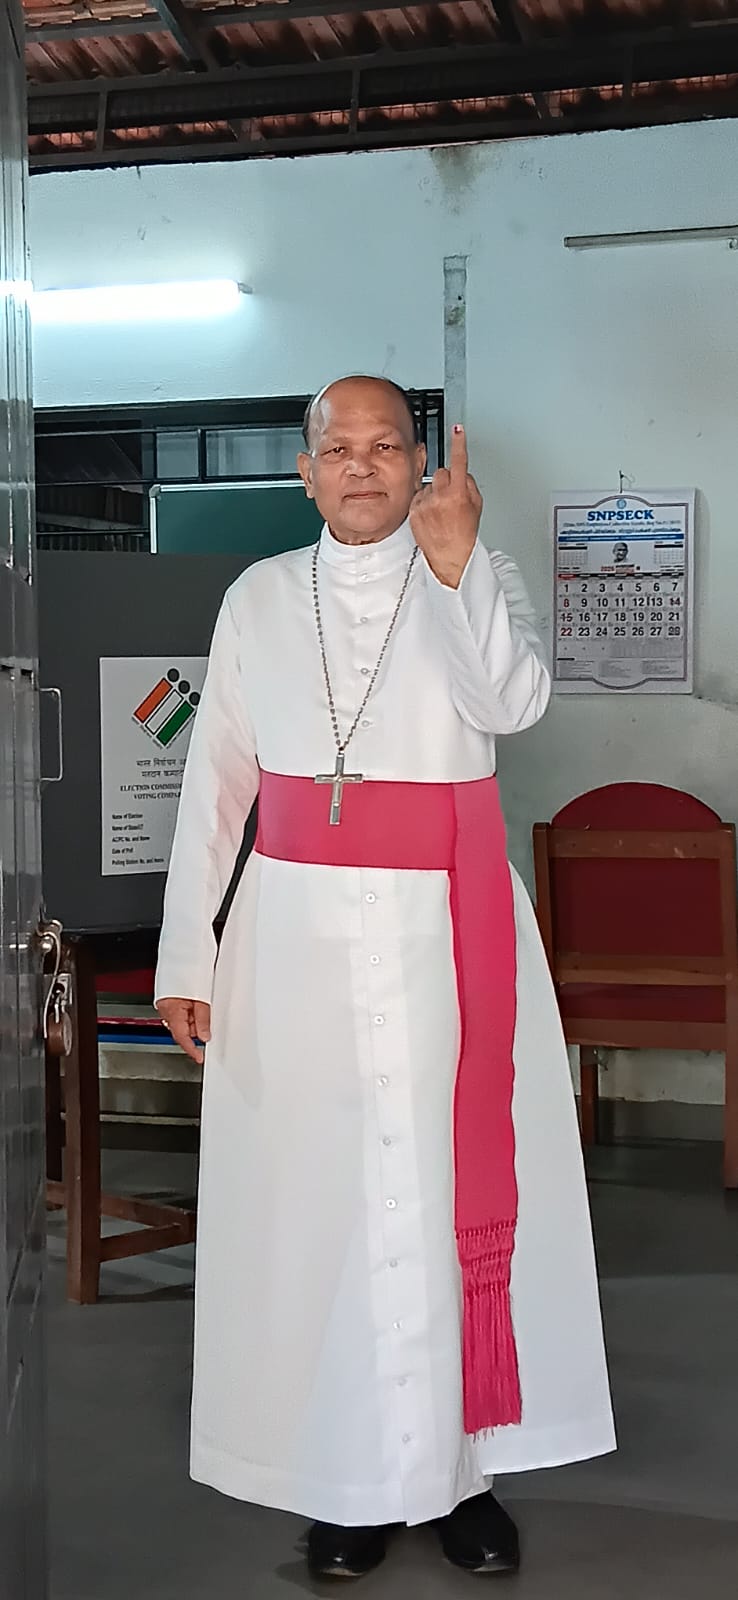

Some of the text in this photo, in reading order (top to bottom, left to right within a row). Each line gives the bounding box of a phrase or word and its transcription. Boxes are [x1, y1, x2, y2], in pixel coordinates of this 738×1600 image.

[587, 509, 655, 521] SNPSECK
[565, 582, 678, 592] 1 2 3 4 5 6 7
[563, 597, 681, 607] 8 9 10 11 12 13 14
[561, 612, 680, 622] 15 16 17 18 19 20 21
[560, 628, 572, 637] 22
[578, 627, 590, 636] 23
[596, 627, 608, 636] 24
[614, 627, 626, 636] 25
[632, 627, 644, 636] 26
[650, 627, 662, 636] 27
